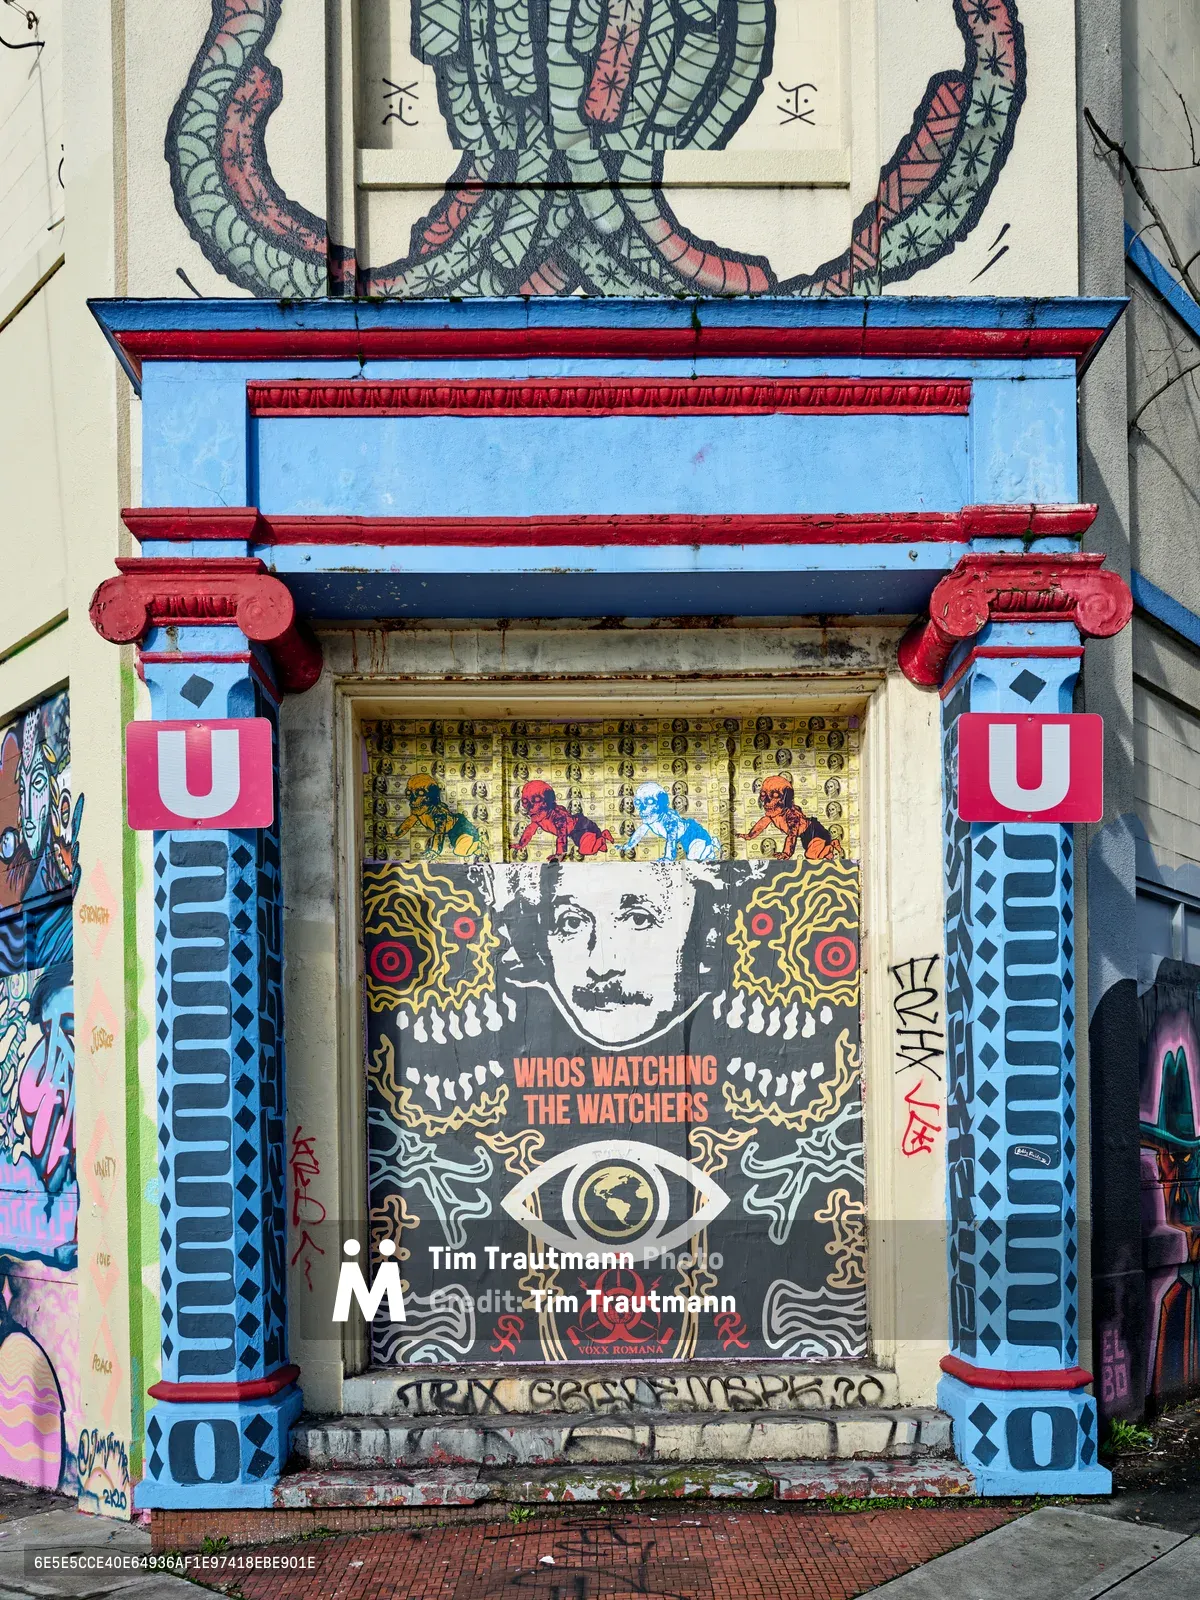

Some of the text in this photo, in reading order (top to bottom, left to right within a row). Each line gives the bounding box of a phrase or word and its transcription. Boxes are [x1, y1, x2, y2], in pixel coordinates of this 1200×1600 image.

[157, 729, 240, 819] U
[988, 723, 1070, 812] U
[513, 1055, 717, 1088] WHOS WATCHING
[523, 1092, 708, 1125] THE WATCHERS
[96, 1252, 111, 1265] LOVE
[578, 1345, 664, 1355] VOXX ROMANA
